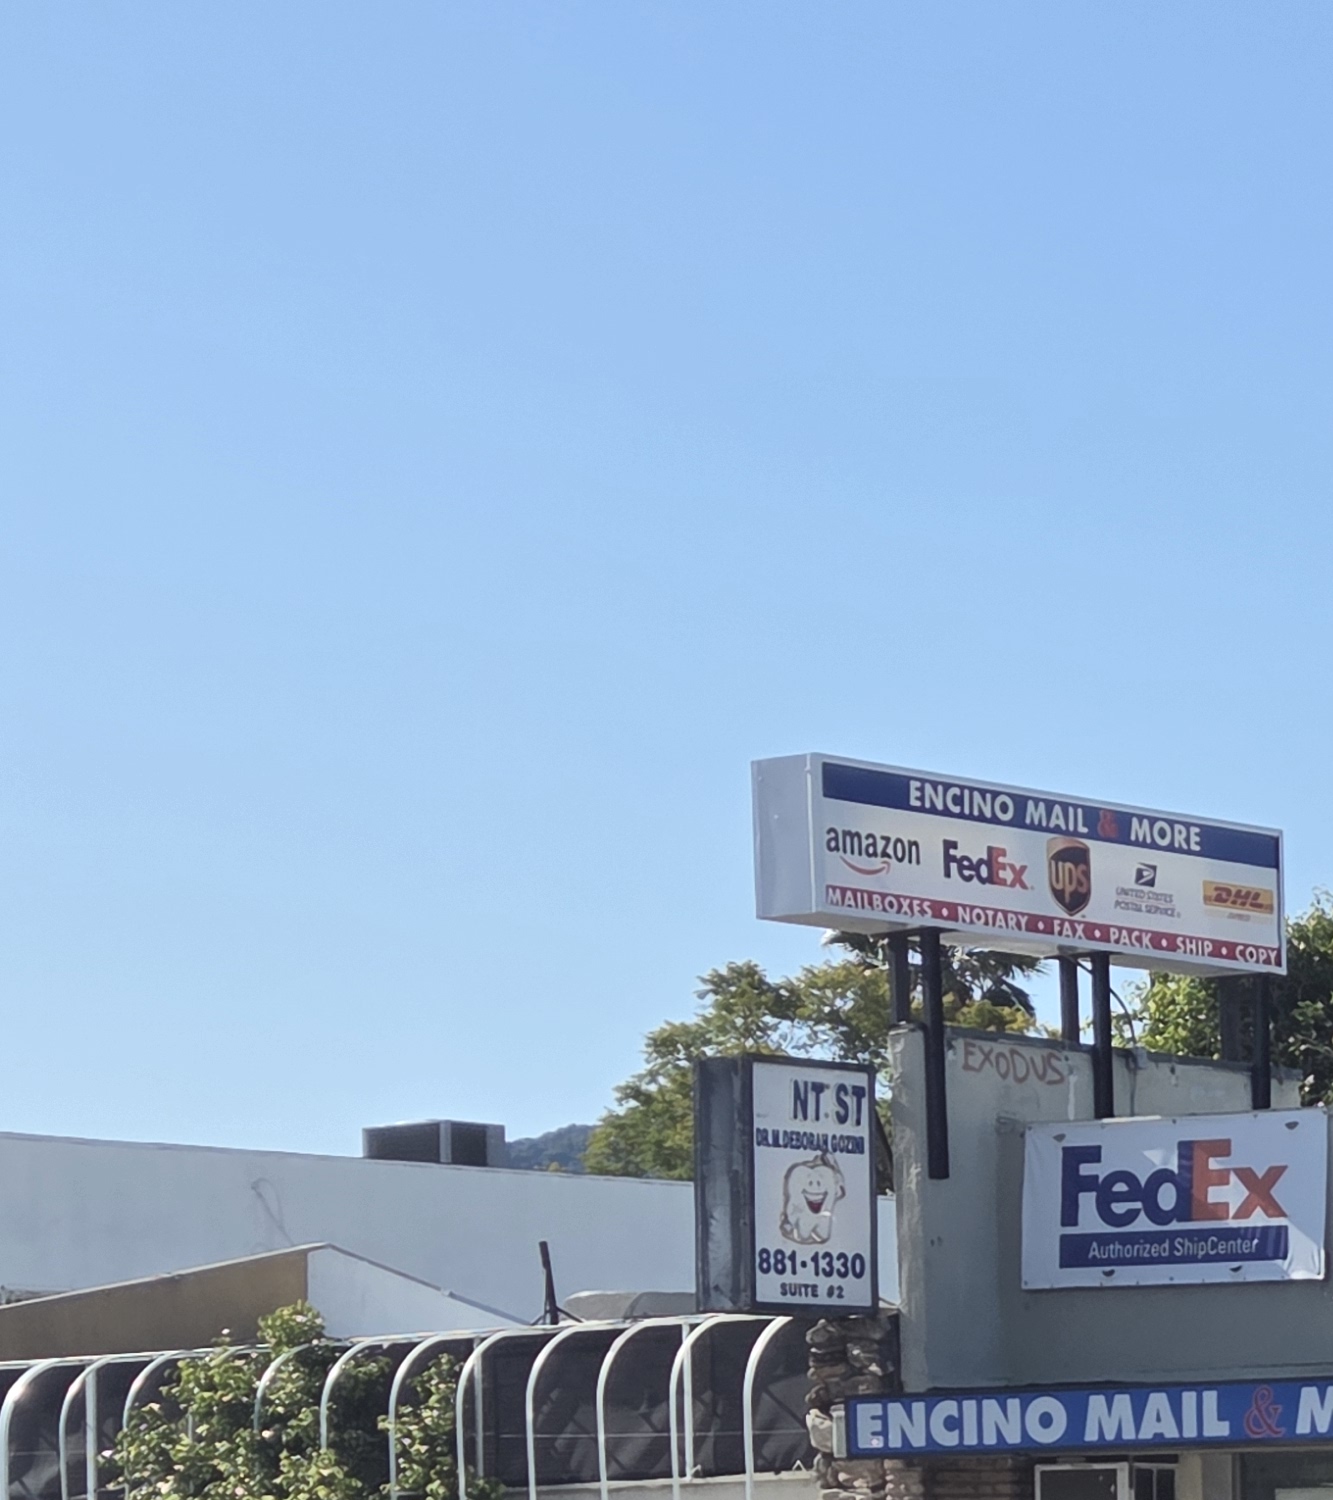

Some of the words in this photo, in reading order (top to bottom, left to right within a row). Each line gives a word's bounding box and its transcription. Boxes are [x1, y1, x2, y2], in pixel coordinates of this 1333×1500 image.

[909, 780, 1015, 822] ENCINO
[1025, 800, 1089, 834] MAIL
[1097, 809, 1119, 839] &
[1130, 816, 1201, 851] MORE
[825, 827, 921, 865] amazon
[943, 839, 1029, 890] FedEx
[1050, 858, 1088, 904] ups
[1213, 886, 1264, 910] DHL
[827, 888, 932, 918] MAILBOXES
[957, 906, 1029, 932] NOTARY
[1053, 919, 1086, 940] FAX
[1109, 927, 1152, 949] PACK
[1176, 936, 1213, 957] SHIP
[1235, 945, 1279, 966] COPY
[962, 1038, 1065, 1086] EXODUS
[1060, 1138, 1288, 1228] FedEx
[1088, 1238, 1169, 1261] Authorized
[1173, 1235, 1258, 1261] ShipCenter
[780, 1282, 819, 1298] SUITE
[855, 1396, 1067, 1450] ENCINO
[1083, 1389, 1230, 1442] MAIL
[1243, 1385, 1285, 1438] &
